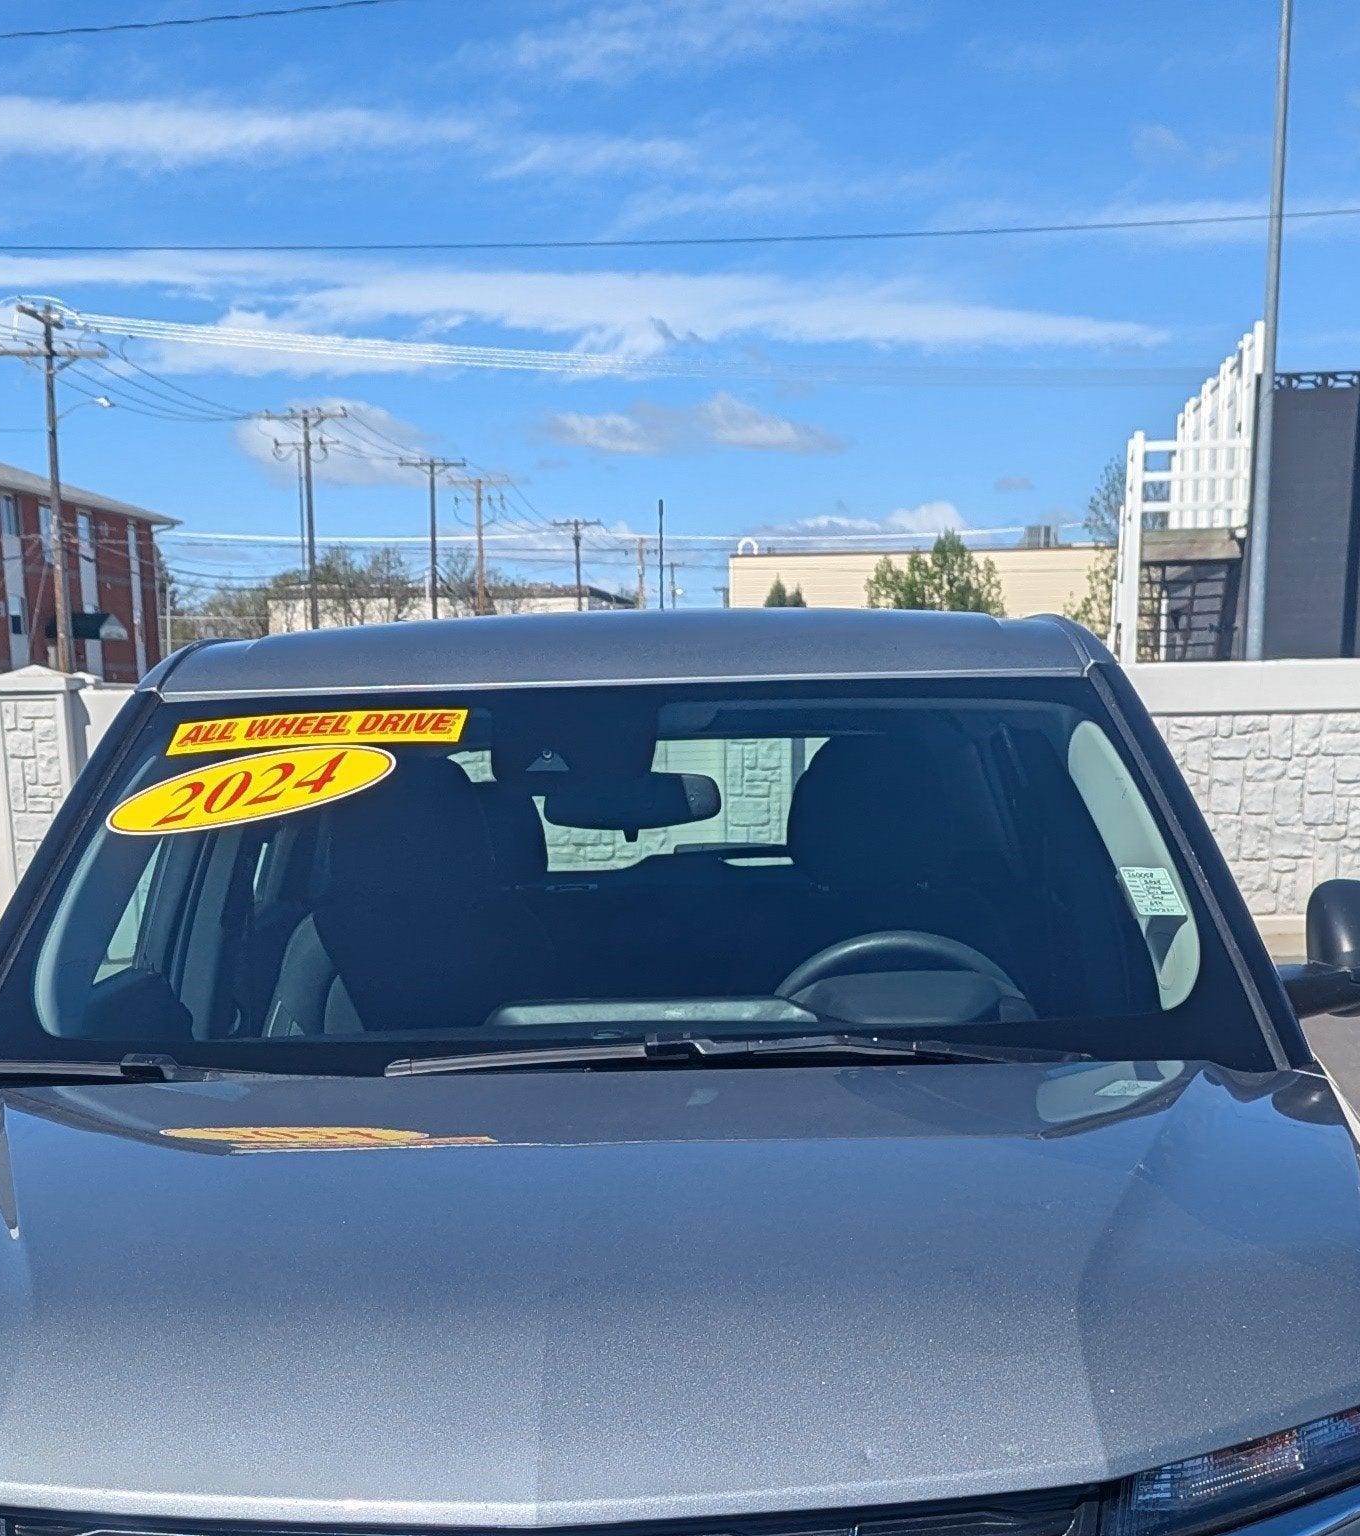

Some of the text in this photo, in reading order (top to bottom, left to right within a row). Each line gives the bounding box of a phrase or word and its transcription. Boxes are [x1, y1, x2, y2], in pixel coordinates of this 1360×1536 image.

[178, 711, 459, 748] ALL WHEEL DRIVE
[151, 751, 349, 828] 2024
